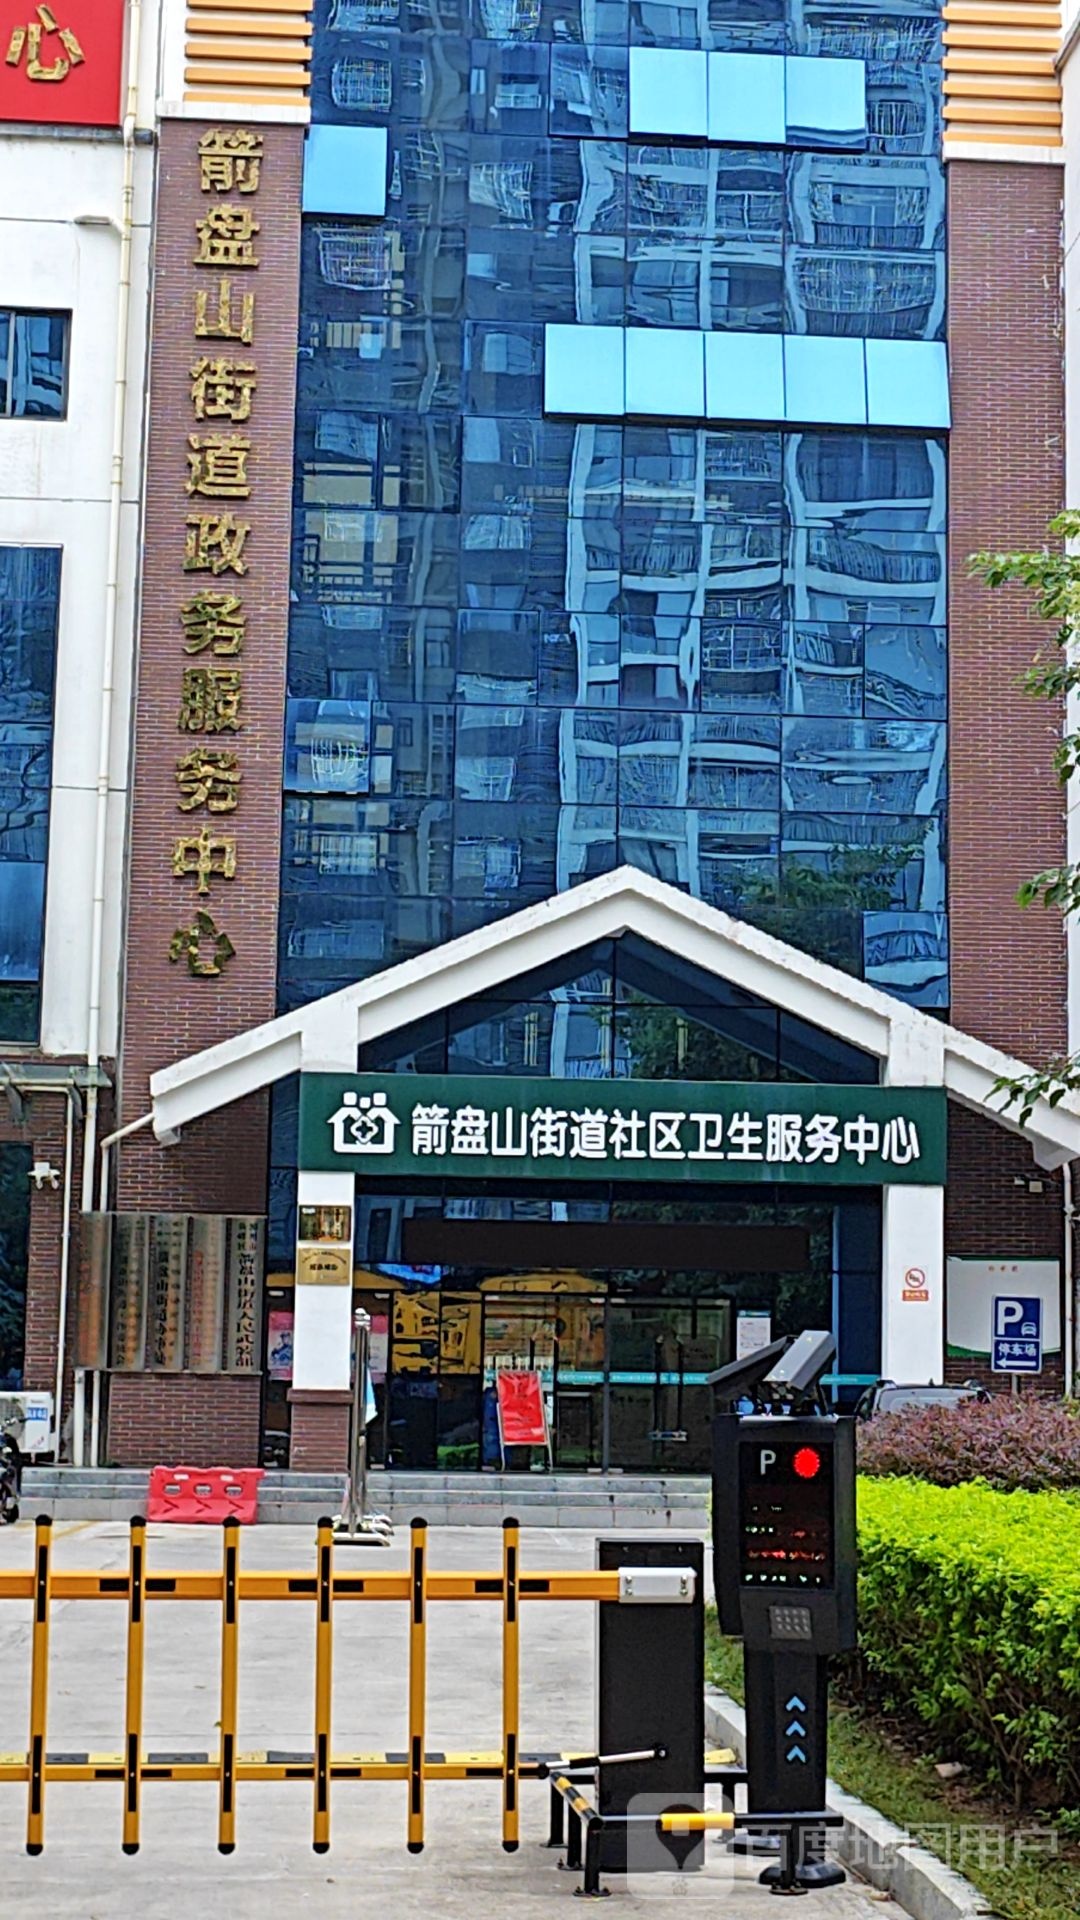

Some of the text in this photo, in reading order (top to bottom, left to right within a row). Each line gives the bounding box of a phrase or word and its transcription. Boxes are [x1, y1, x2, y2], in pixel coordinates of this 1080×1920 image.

[6, 4, 85, 82] 心
[168, 127, 264, 978] 箭盘山街道政务服务中心
[411, 1102, 921, 1166] 箭盘山街道社区卫生服务中心
[997, 1301, 1024, 1336] P
[998, 1343, 1037, 1357] 停车场
[760, 1449, 777, 1475] P
